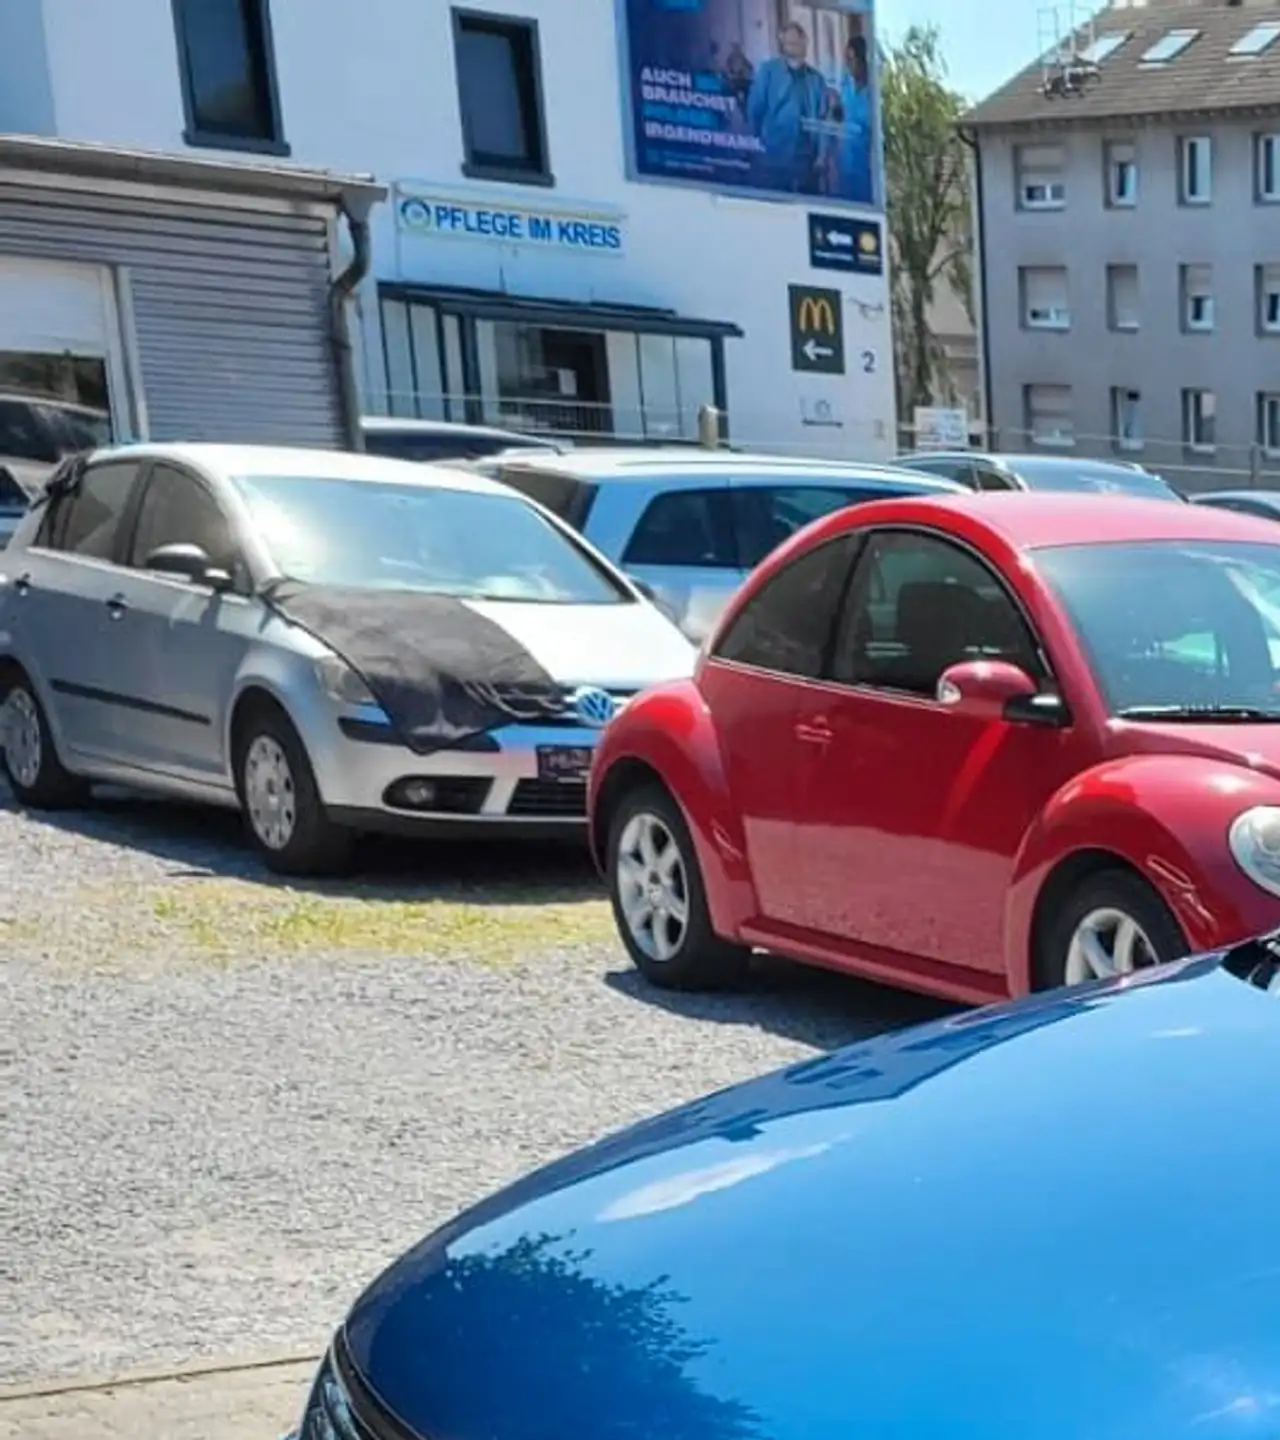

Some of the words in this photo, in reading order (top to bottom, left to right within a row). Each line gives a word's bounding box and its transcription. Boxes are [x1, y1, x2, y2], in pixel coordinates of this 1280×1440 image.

[641, 66, 692, 89] AUCH
[434, 205, 523, 238] PFLEGE
[528, 217, 553, 241] IM
[558, 220, 622, 249] KREIS
[861, 350, 876, 374] 2
